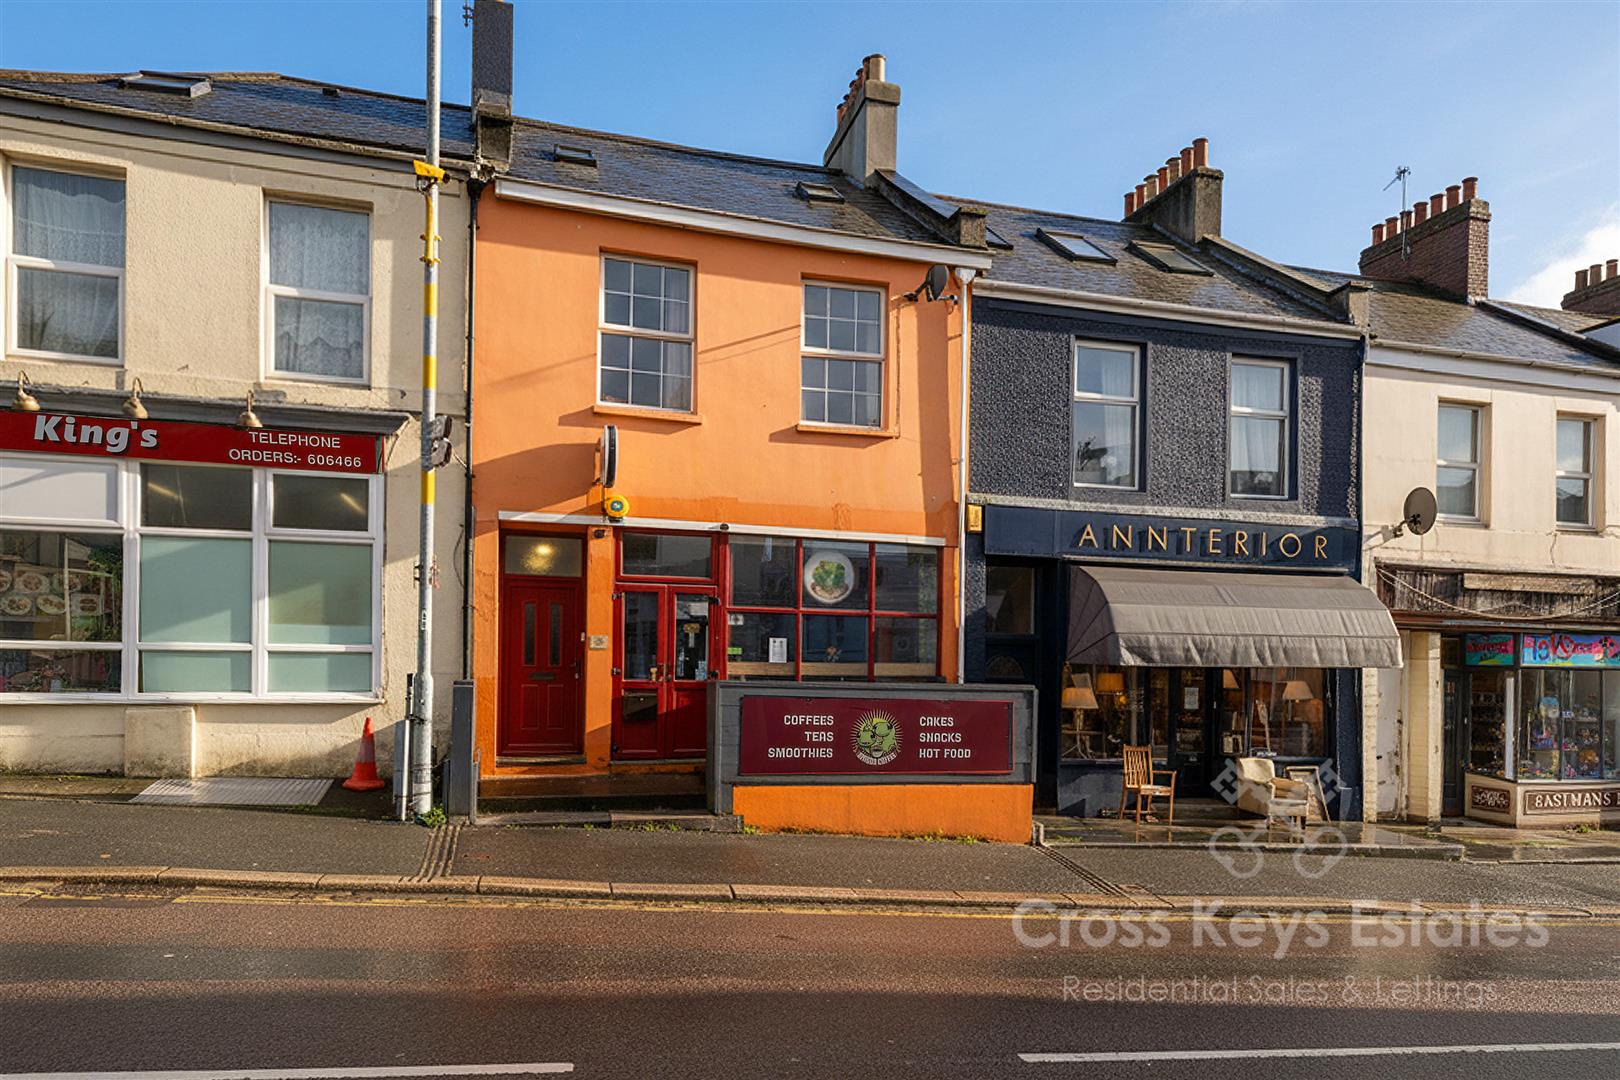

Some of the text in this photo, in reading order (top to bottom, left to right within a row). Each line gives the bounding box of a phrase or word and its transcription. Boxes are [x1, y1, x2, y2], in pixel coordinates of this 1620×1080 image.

[34, 415, 160, 454] King's
[249, 431, 341, 449] TELEPHONE
[307, 454, 362, 468] 606466
[1078, 523, 1329, 560] ANNTERIOR
[783, 715, 834, 727] COFFEES
[919, 716, 954, 727] CAKES
[804, 731, 834, 742] TEAS
[919, 732, 962, 743] SNACKS
[767, 747, 834, 759] SMOOTHIES
[919, 748, 971, 759] HOT FOOD
[1535, 791, 1611, 807] EASTMANS
